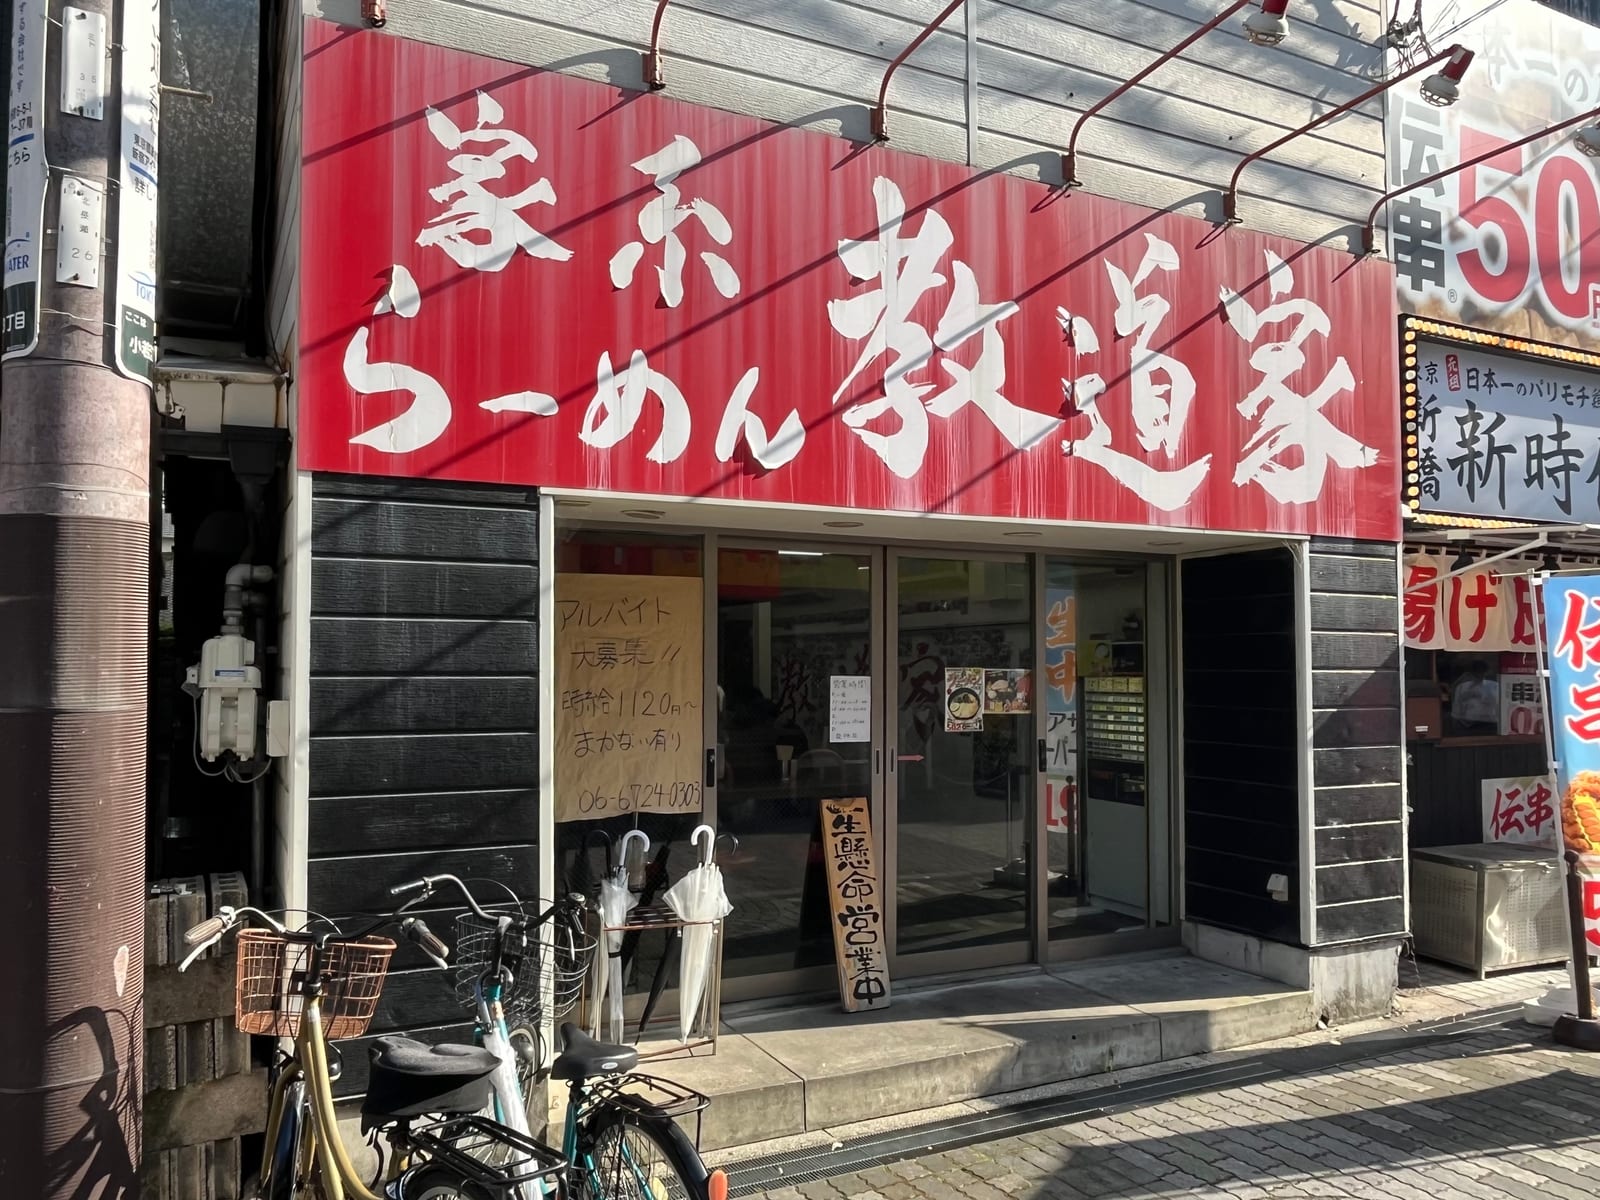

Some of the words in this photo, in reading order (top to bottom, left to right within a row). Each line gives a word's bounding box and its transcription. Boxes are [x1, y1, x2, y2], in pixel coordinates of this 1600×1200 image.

[1389, 93, 1446, 291] 伝串
[343, 264, 807, 470] らーめん
[827, 176, 1379, 511] 教道家
[556, 596, 672, 632] アルバイト
[574, 728, 681, 757] まかない有り
[1489, 782, 1554, 841] 伝串
